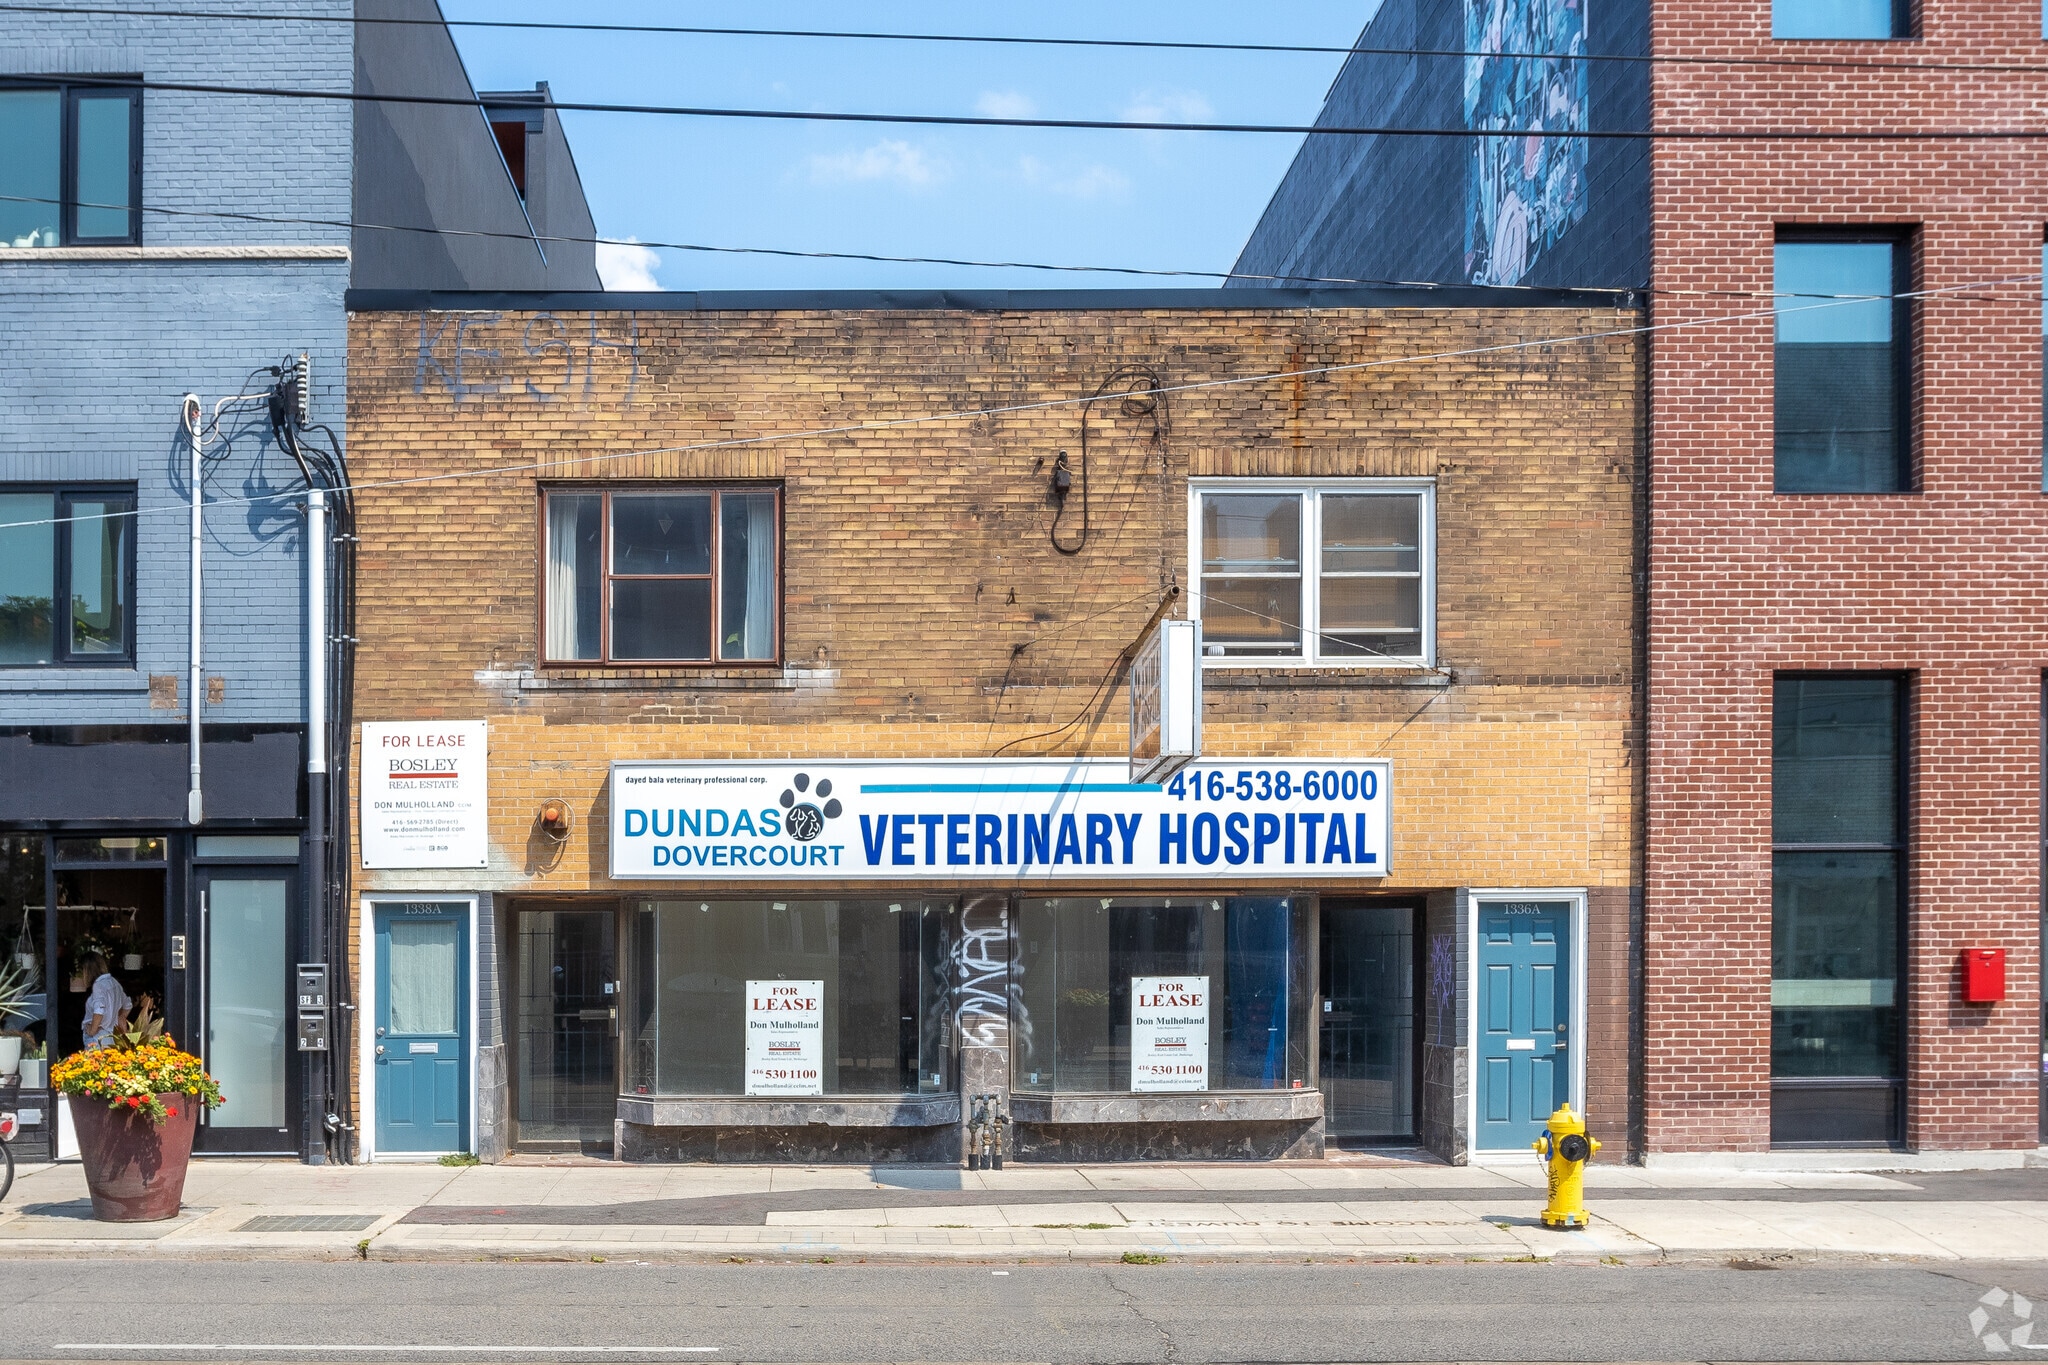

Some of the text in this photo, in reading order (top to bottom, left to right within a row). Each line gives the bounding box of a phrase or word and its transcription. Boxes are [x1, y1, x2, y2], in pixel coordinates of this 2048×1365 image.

[383, 734, 466, 748] FOR LEASE
[390, 758, 458, 772] BOSLEY
[389, 780, 458, 790] REAL ESTATE
[625, 775, 768, 785] dayed bala veterinary professional corp.
[1167, 769, 1377, 802] 416-538-6000
[374, 801, 393, 809] DON
[395, 800, 455, 809] MULHOLLAND
[624, 808, 782, 838] DUNDAS
[859, 812, 1377, 866] VETERINARY HOSPITAL
[653, 845, 845, 866] DOVERCOURT
[405, 903, 442, 915] 1338A
[1504, 903, 1542, 915] 1336A
[773, 987, 798, 996] FOR
[1159, 983, 1184, 992] FOR
[754, 998, 816, 1011] LEASE
[1140, 994, 1202, 1007] LEASE
[750, 1021, 819, 1029] Don Mulholland
[1136, 1016, 1205, 1025] Don Mulholland
